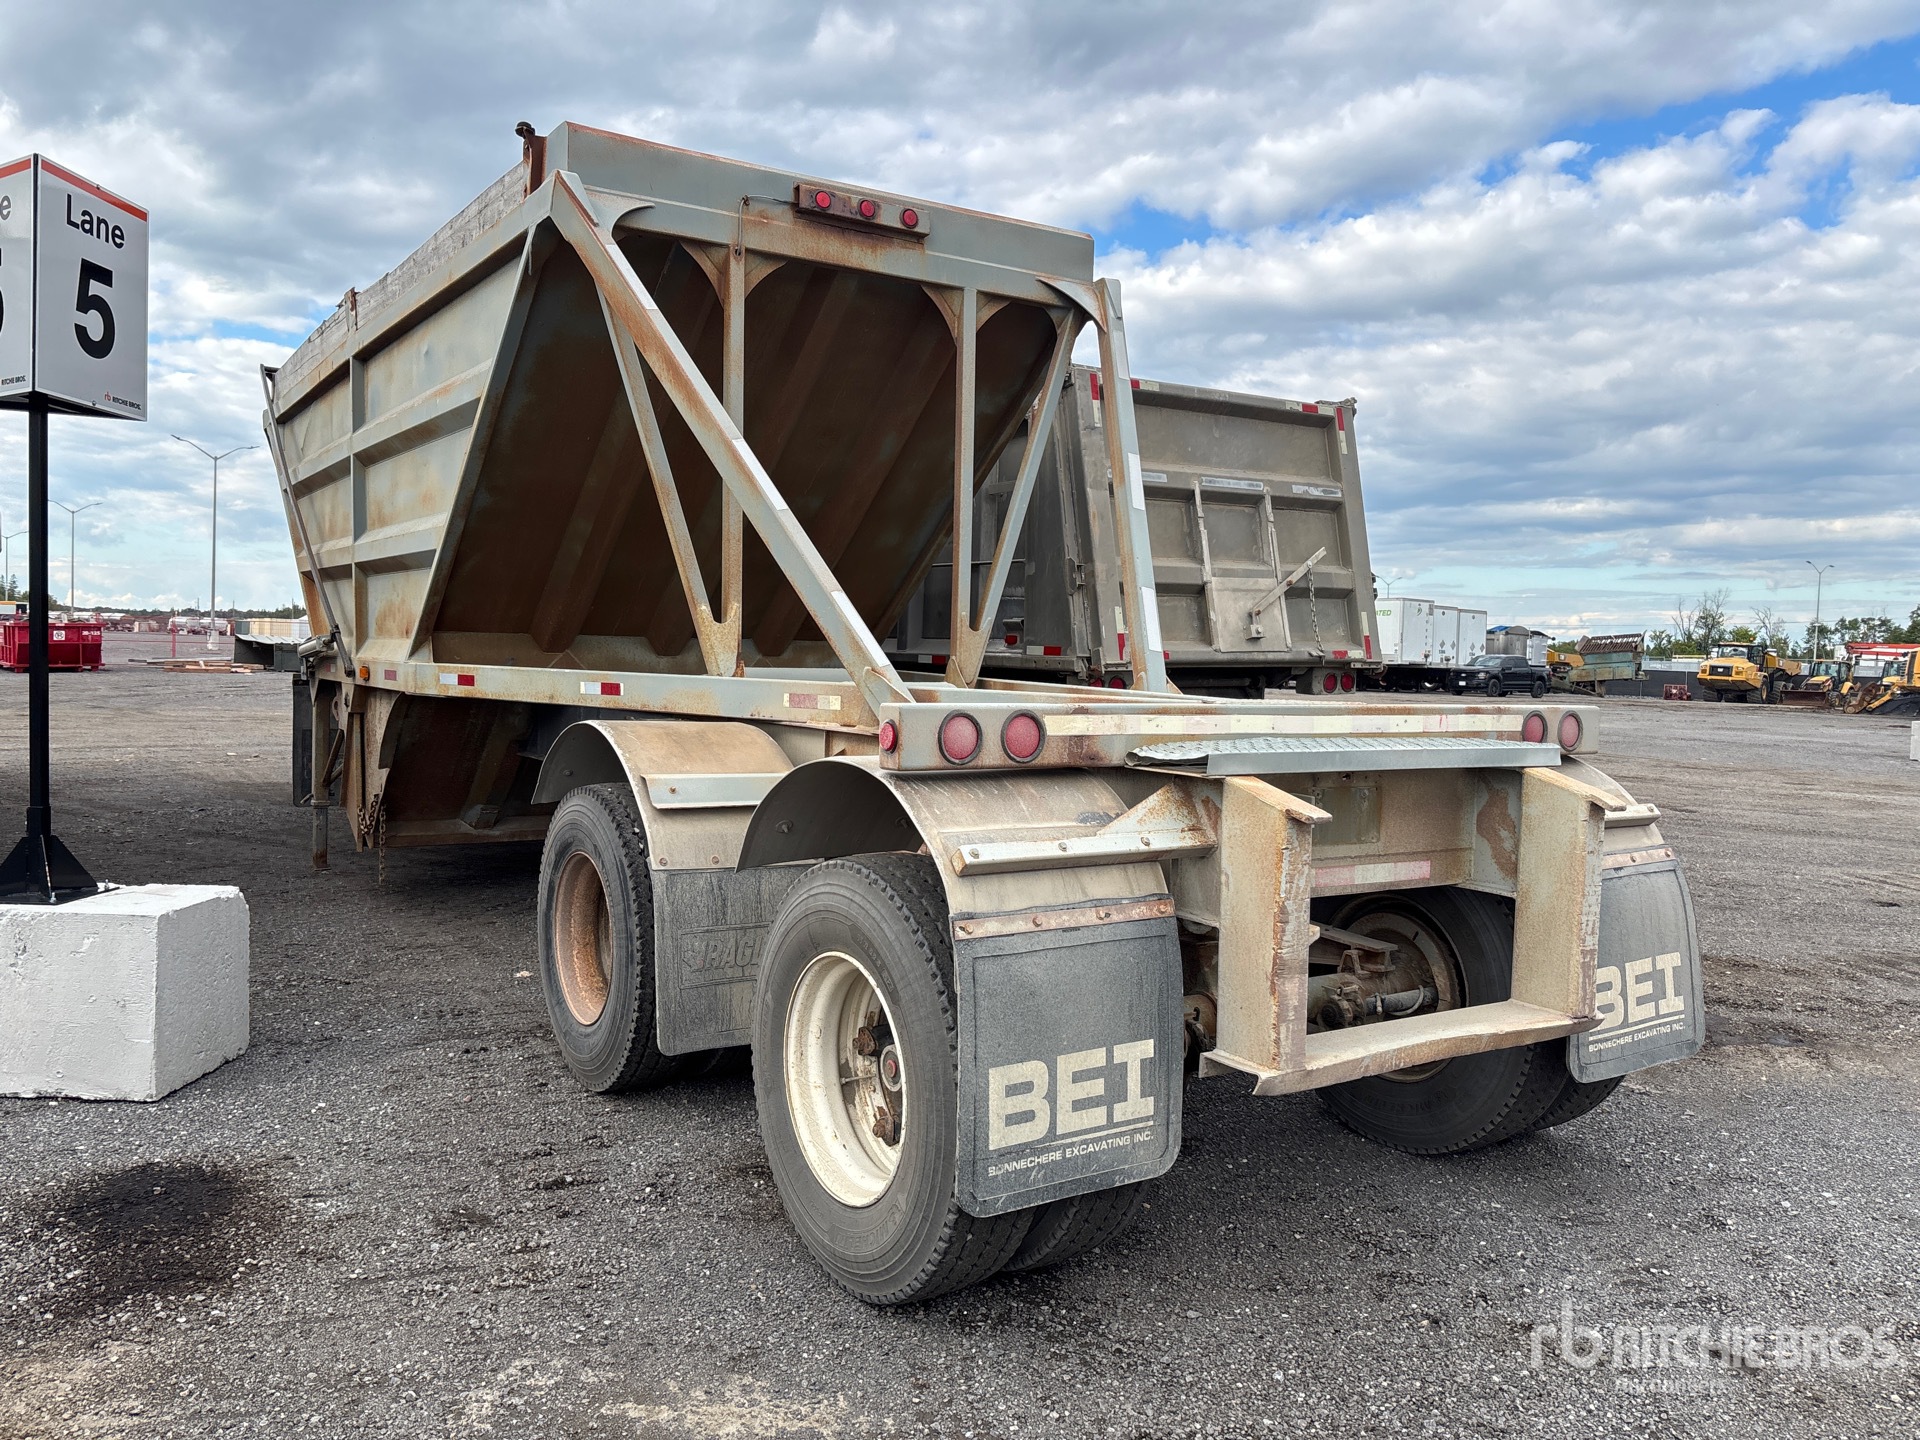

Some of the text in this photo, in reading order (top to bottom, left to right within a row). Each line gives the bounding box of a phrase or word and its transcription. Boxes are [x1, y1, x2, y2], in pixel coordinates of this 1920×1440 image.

[66, 193, 125, 249] Lane
[74, 257, 116, 360] 5
[1589, 952, 1684, 1032] BEI
[1588, 1035, 1633, 1052] BONNECHERE
[1634, 1025, 1671, 1041] EXCAVATING
[989, 1038, 1154, 1151] BEI
[988, 1131, 1154, 1177] BONNECHERE EXCAVATING INC.
